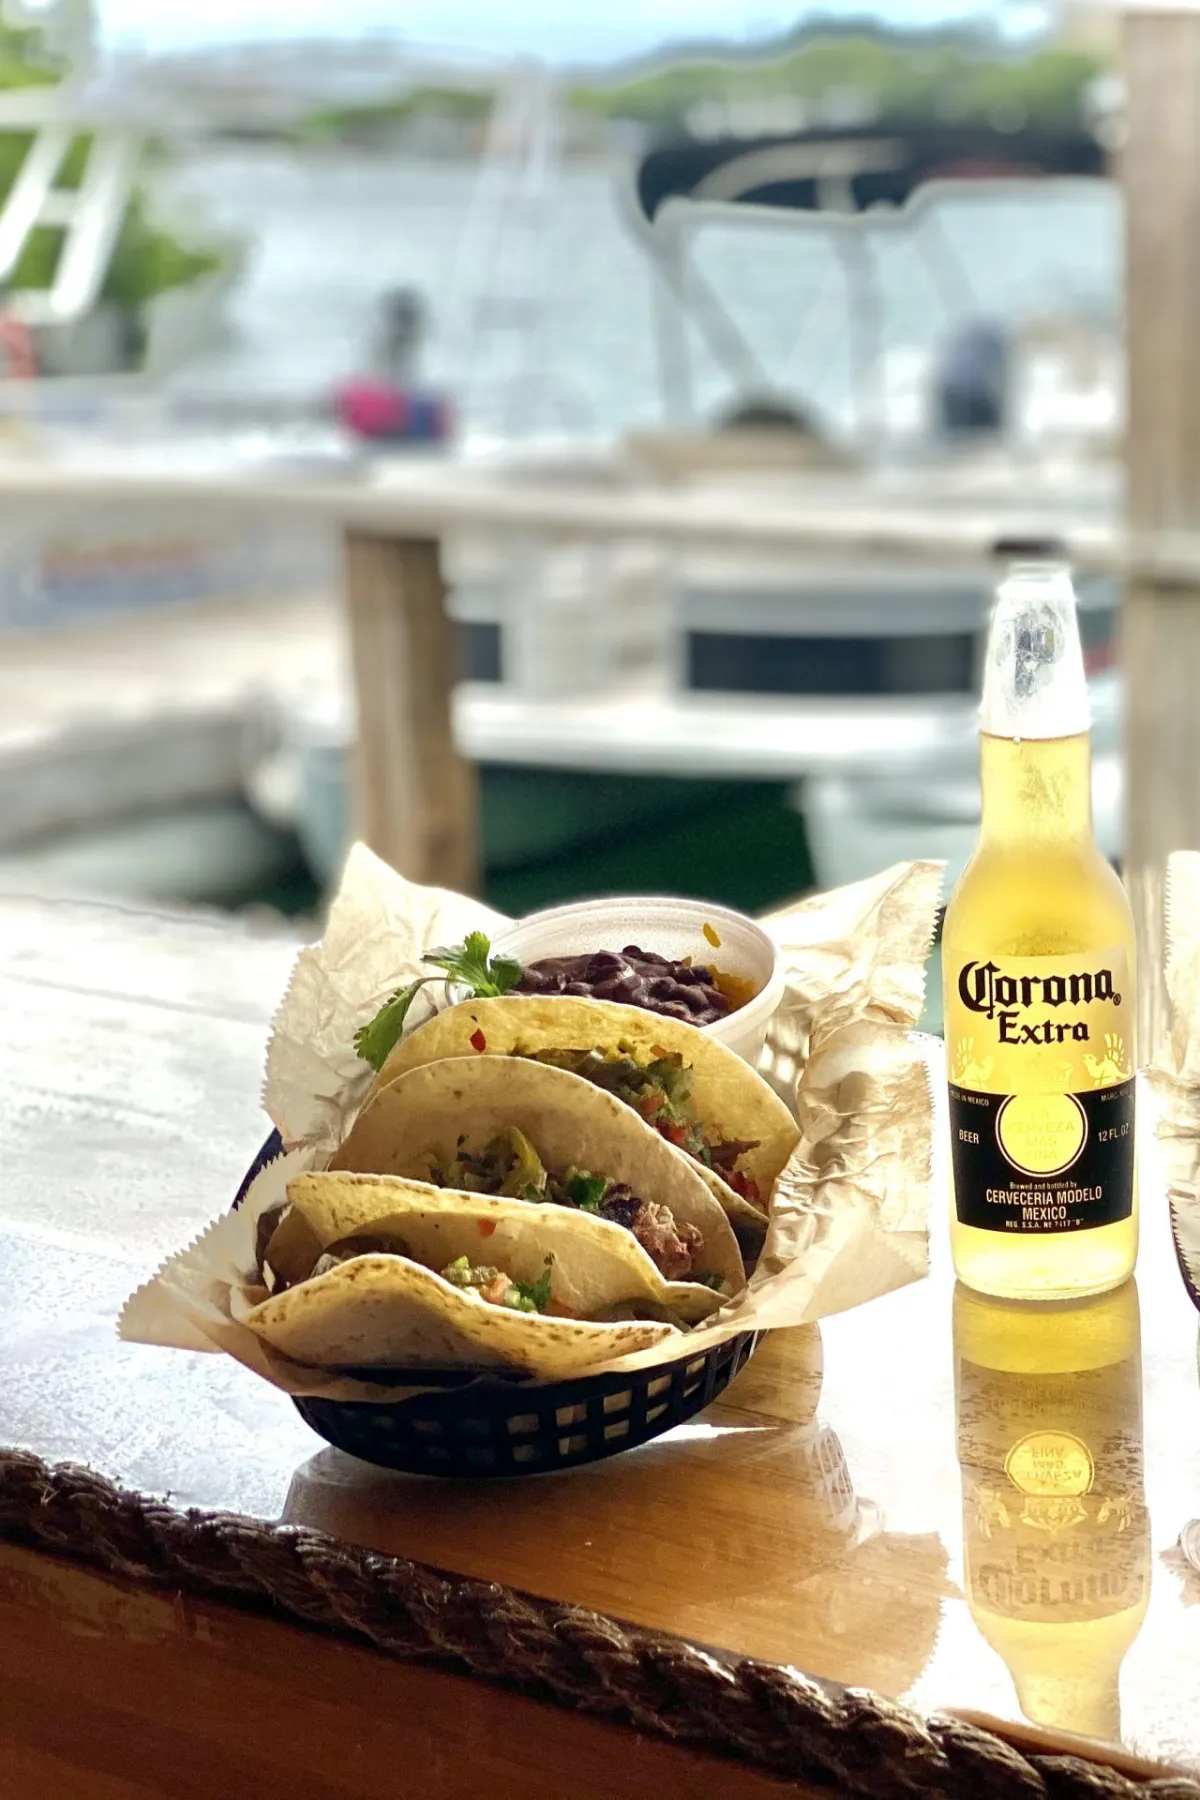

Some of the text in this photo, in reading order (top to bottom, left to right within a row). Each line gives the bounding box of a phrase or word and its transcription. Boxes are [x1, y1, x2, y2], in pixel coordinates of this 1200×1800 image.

[958, 961, 1115, 1020] Corona
[997, 1010, 1090, 1045] Extra
[959, 1129, 980, 1145] BEER
[1098, 1130, 1108, 1142] 12
[1009, 1179, 1077, 1190] Brewed and bottled by
[985, 1185, 1103, 1206] CERVECERIA MODELO
[1022, 1206, 1067, 1220] MEXICO
